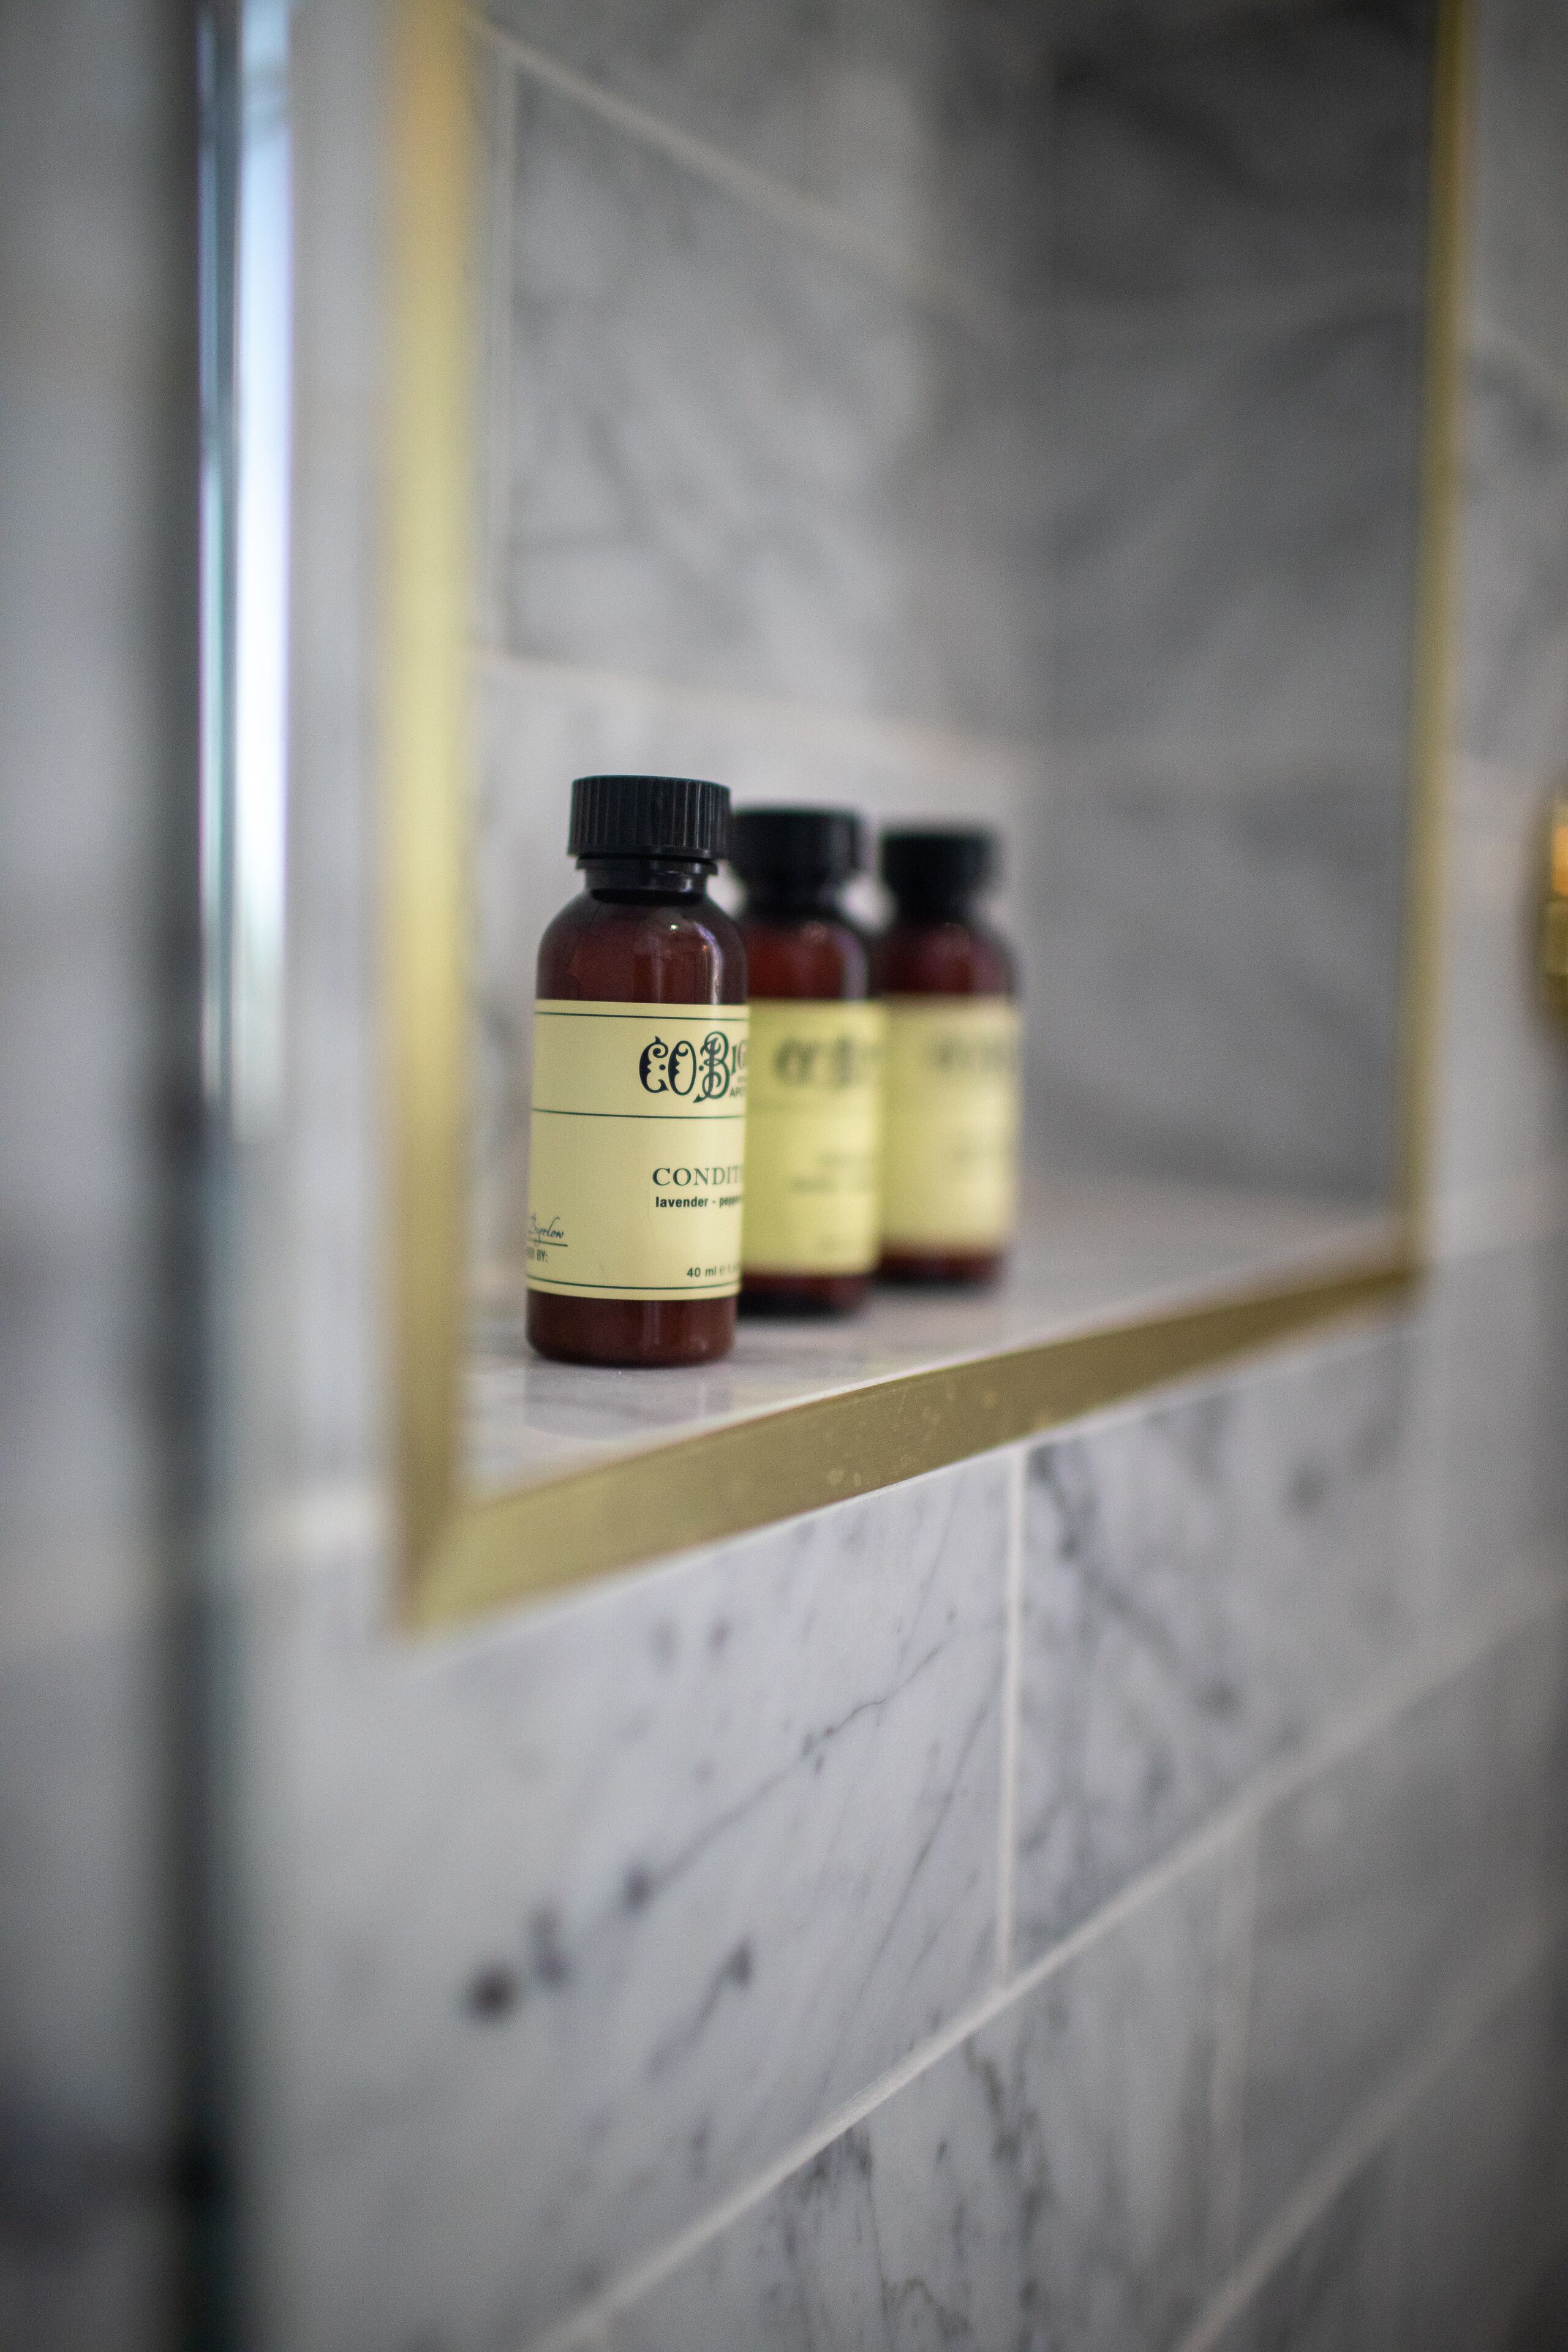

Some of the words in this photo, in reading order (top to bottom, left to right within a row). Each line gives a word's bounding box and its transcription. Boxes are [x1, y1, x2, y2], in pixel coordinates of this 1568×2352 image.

[656, 1196, 709, 1208] lavender
[687, 1267, 701, 1278] 40
[705, 1266, 717, 1276] ml
